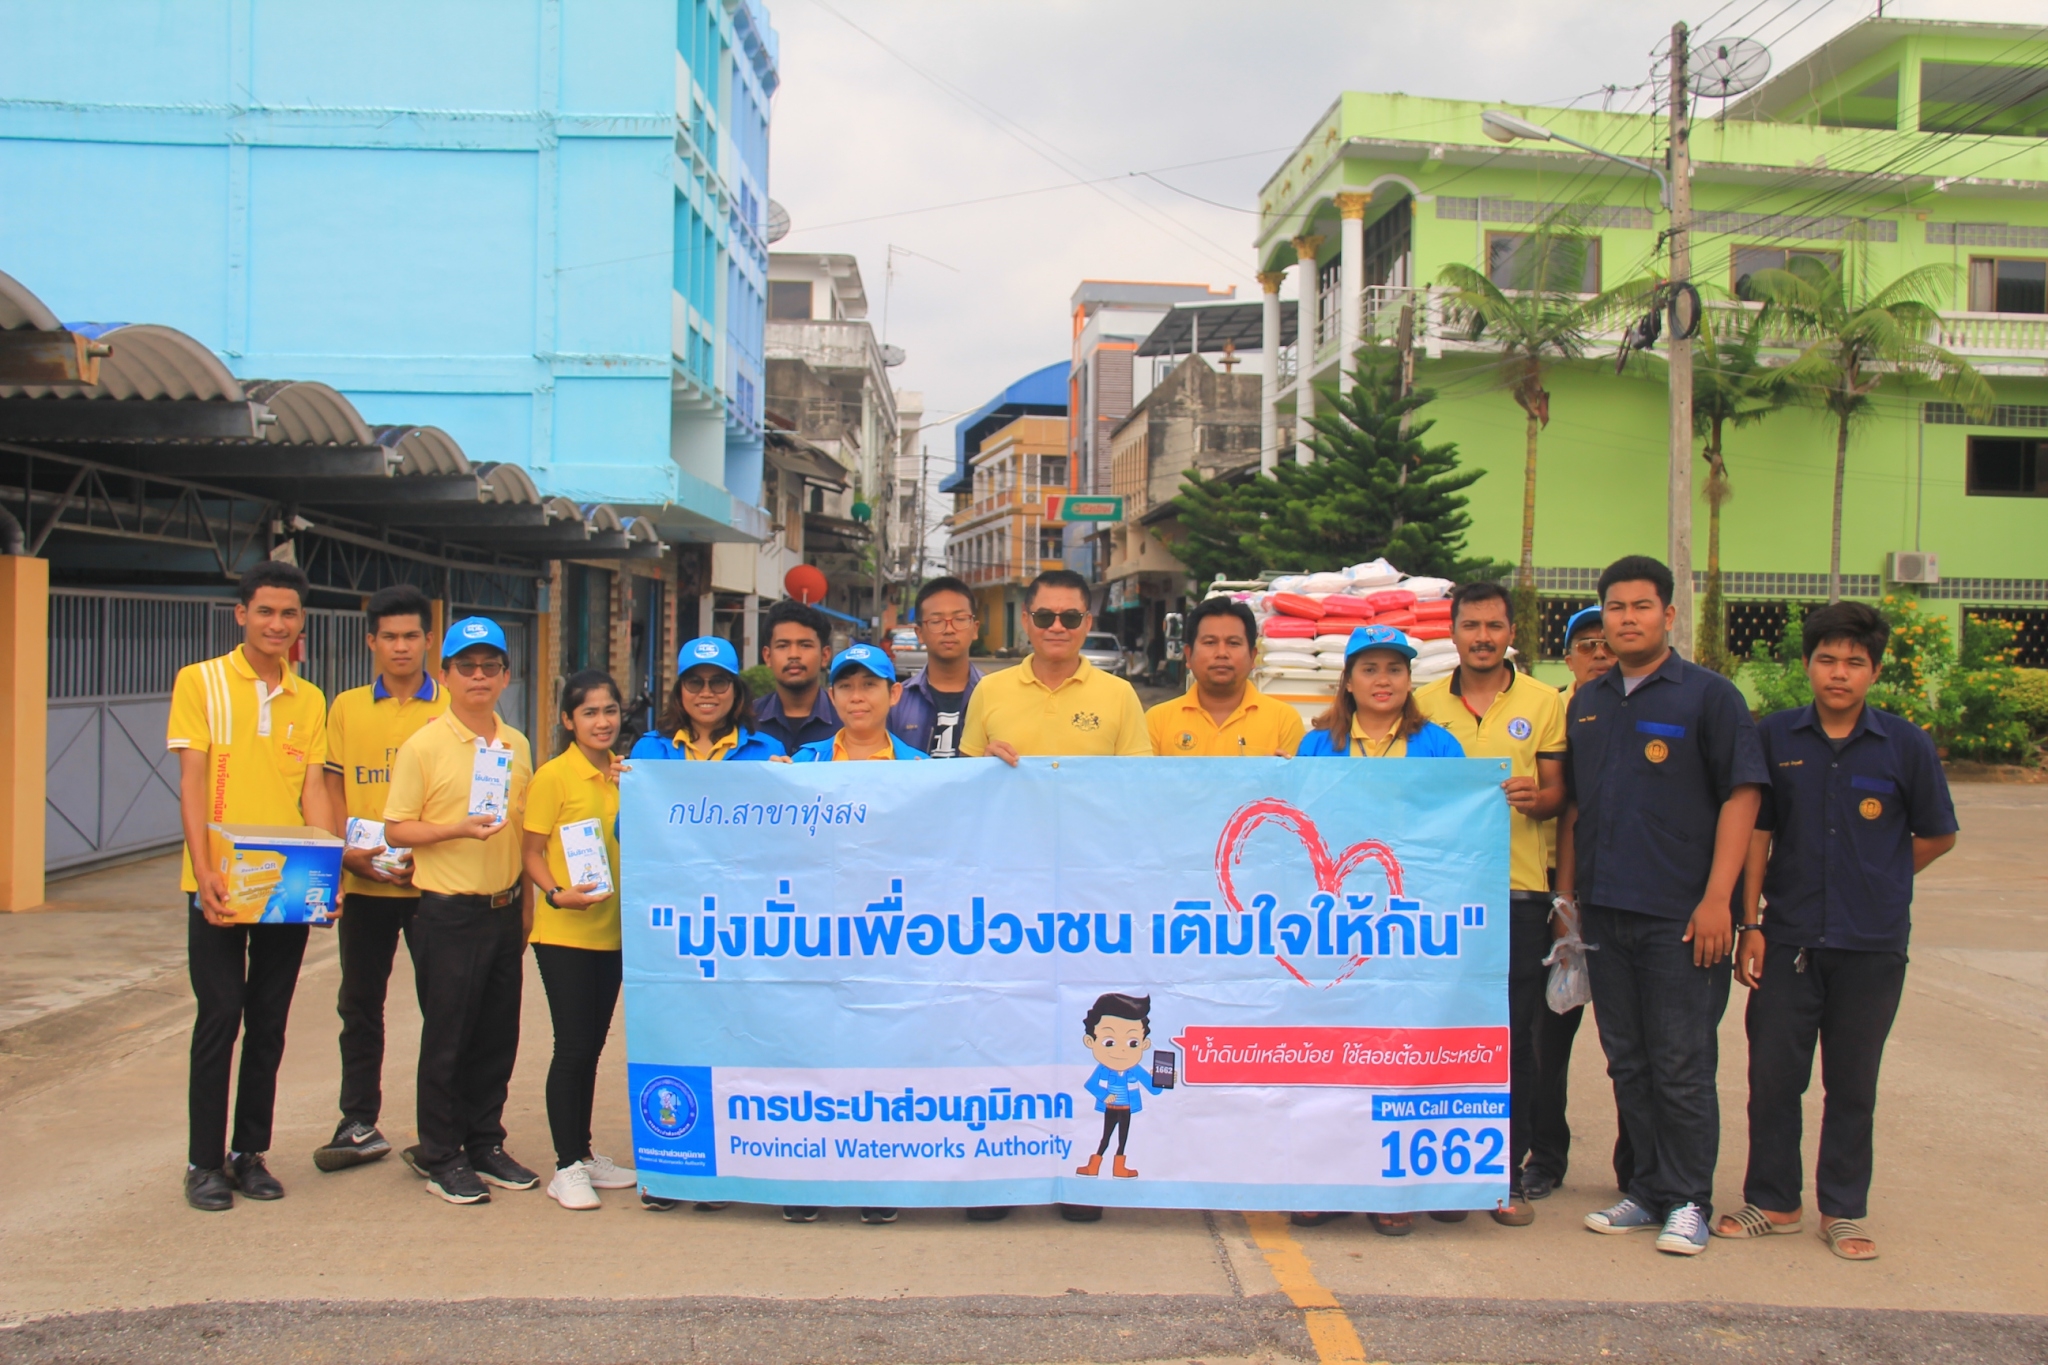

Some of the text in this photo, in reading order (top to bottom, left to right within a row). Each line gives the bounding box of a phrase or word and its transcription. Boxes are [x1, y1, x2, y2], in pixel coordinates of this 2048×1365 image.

[668, 795, 867, 836] กปภ.สาขาทุ่งสง
[652, 879, 1484, 977] "มุ่งมั่นเพื่อปวงชน เติมใจให้กัน"
[1192, 1036, 1502, 1065] "น้ำดิบมีเหลือน้อย ใช้สอยต้องประหยัด"
[1155, 1066, 1173, 1074] 1662
[728, 1087, 1073, 1131] การประปาส่วนภูมิภาค
[1381, 1099, 1505, 1117] PWA Call Center
[638, 1147, 706, 1160] การประปาส่วนภูมิภาค
[730, 1134, 1072, 1160] Provincial Waterworks Authority
[1382, 1127, 1505, 1178] 1662
